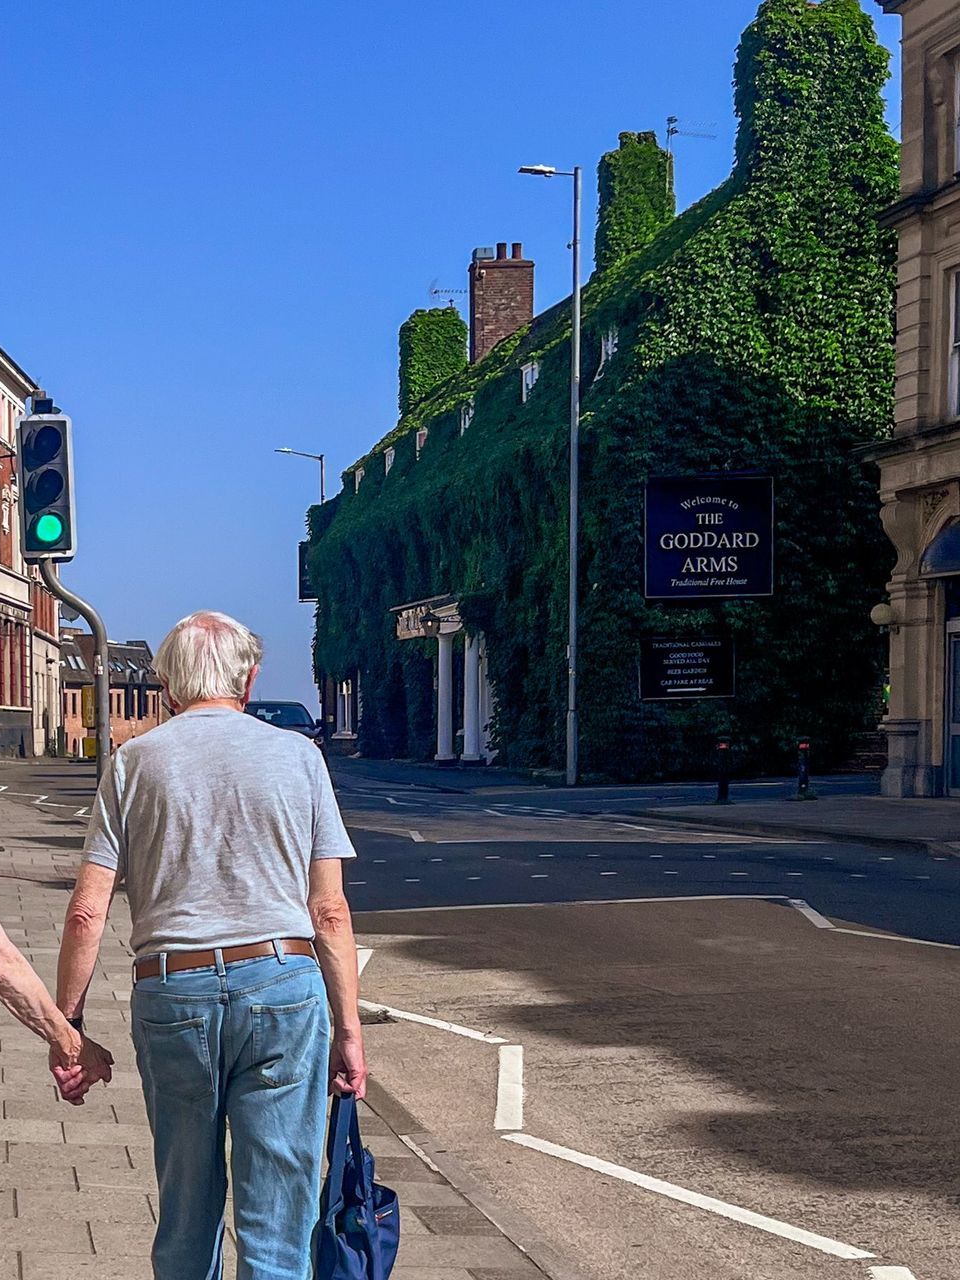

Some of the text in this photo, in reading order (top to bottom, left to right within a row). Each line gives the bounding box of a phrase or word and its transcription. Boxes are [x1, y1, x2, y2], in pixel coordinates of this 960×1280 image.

[680, 496, 739, 510] Welcome to
[695, 513, 724, 525] THE
[660, 531, 760, 550] GODDARD
[681, 556, 738, 573] ARMS
[670, 577, 710, 587] Traditional
